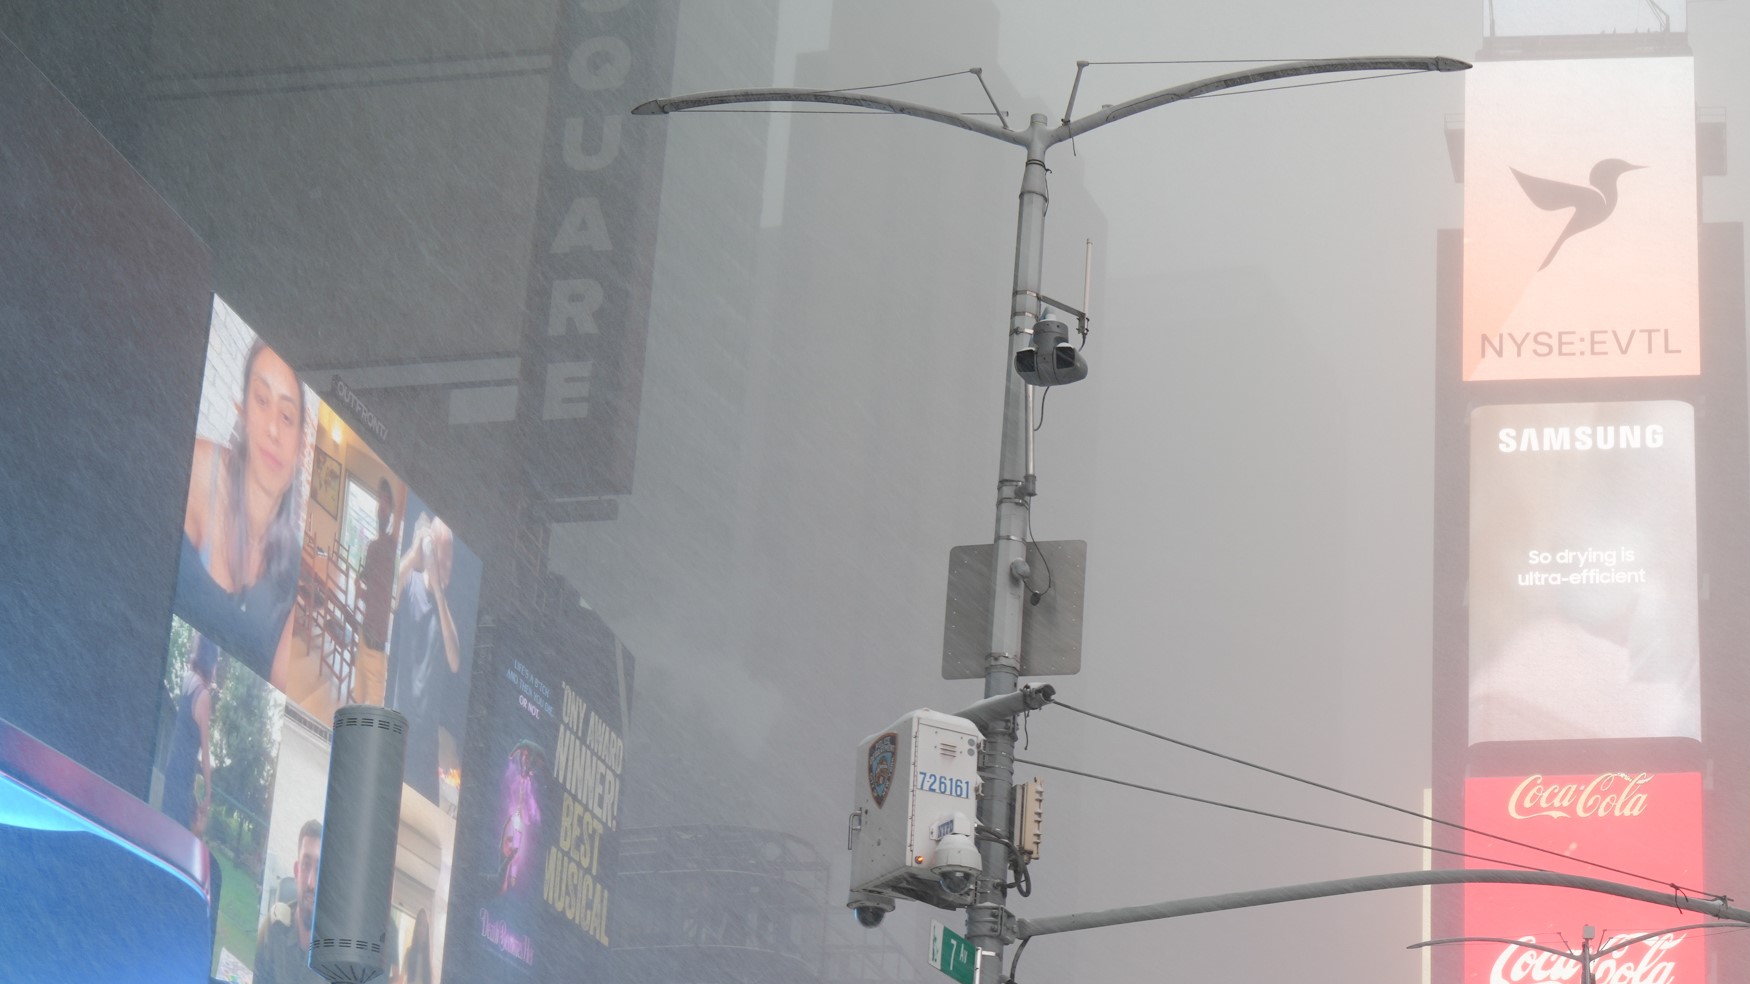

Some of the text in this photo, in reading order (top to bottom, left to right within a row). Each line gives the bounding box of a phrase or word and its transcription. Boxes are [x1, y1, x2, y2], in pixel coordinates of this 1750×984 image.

[542, 0, 632, 420] QUARE
[1479, 328, 1682, 360] NYSE:EVTL
[1498, 424, 1664, 454] SAMSUNG
[1528, 546, 1635, 569] So drying is
[1517, 566, 1646, 587] ultra-efficient
[1508, 772, 1655, 820] Coca-Cola
[559, 792, 604, 876] BEST
[949, 939, 968, 971] 7 Av
